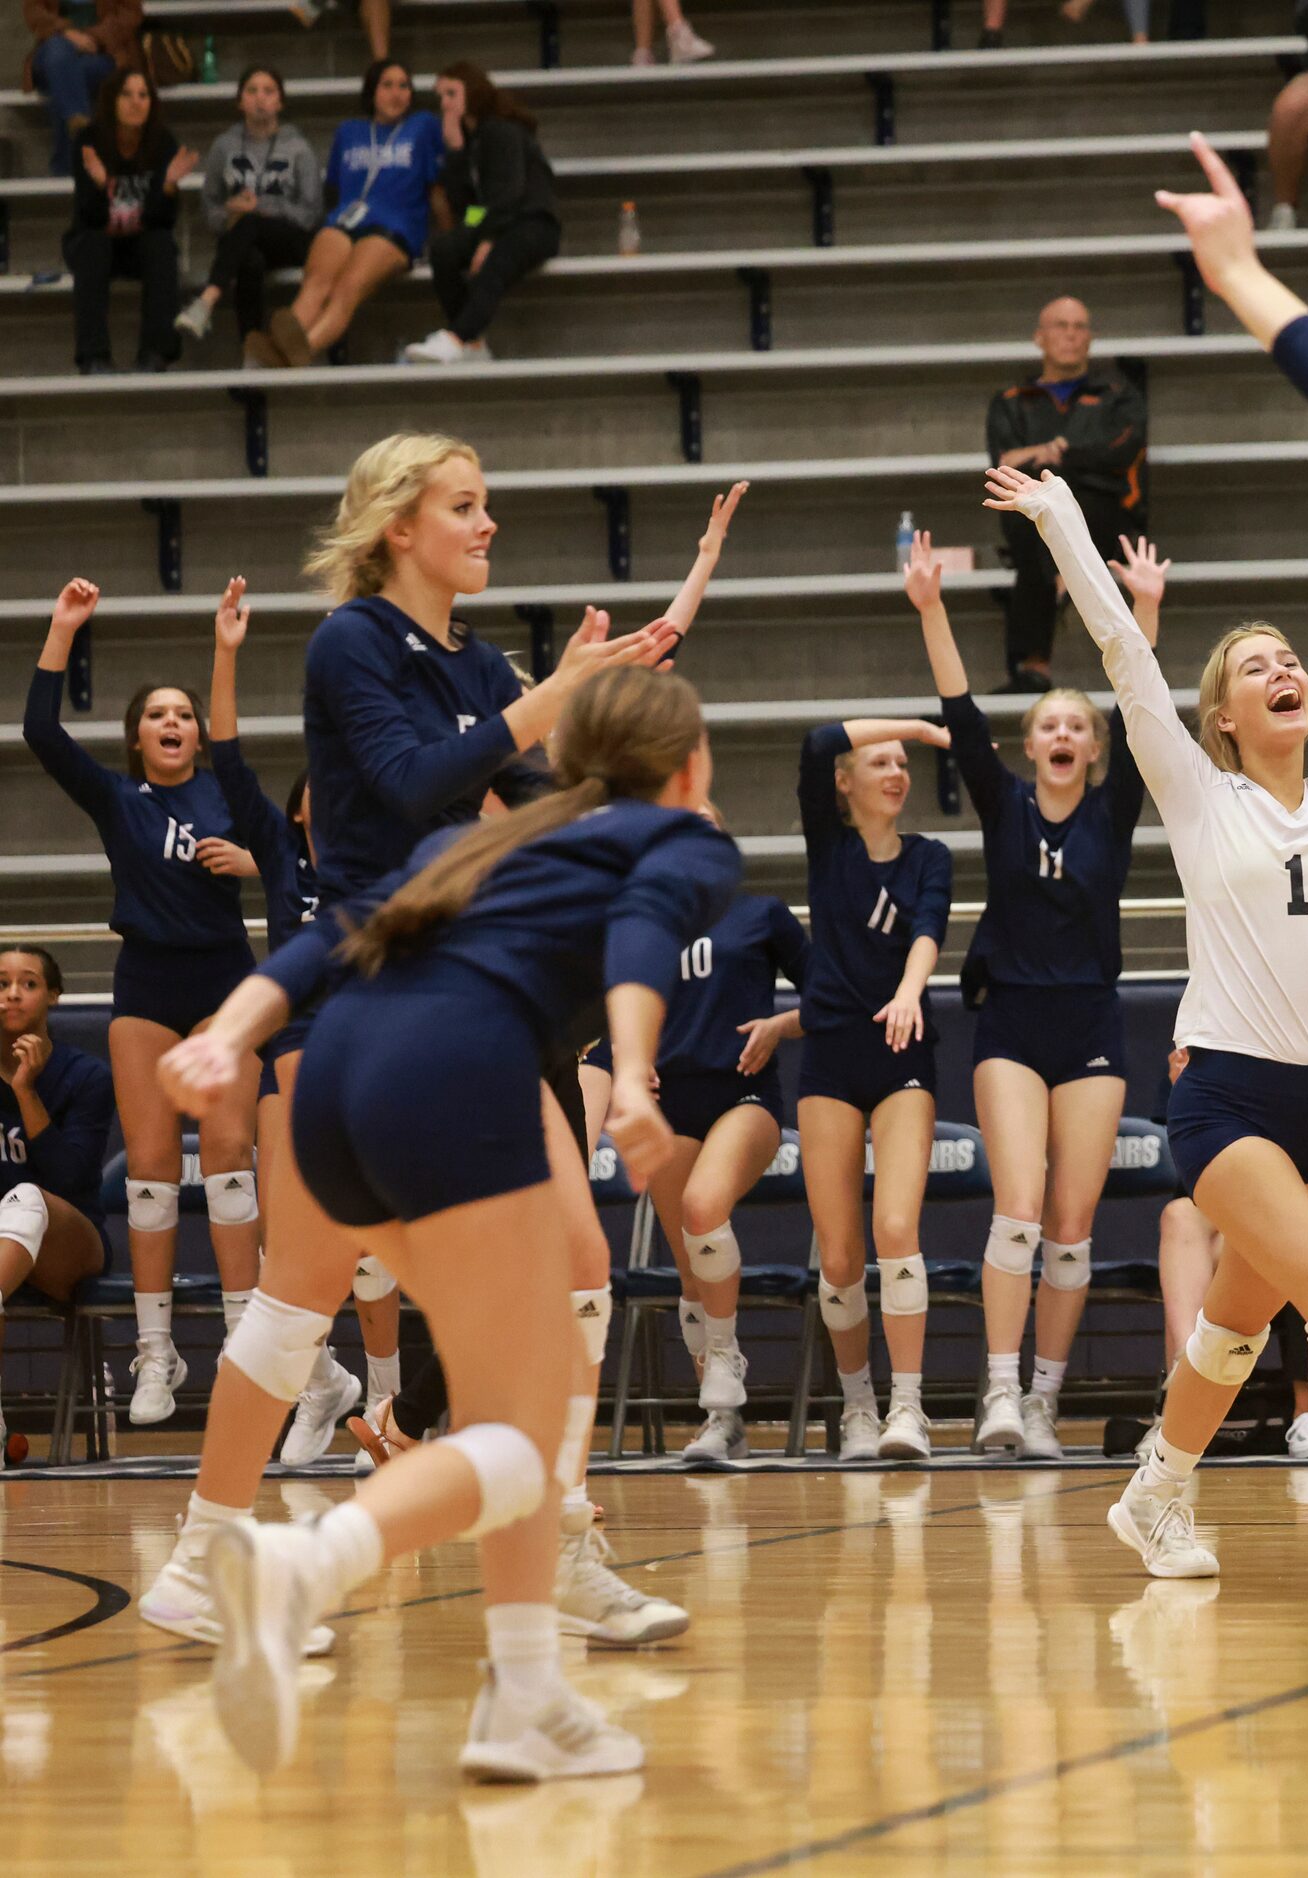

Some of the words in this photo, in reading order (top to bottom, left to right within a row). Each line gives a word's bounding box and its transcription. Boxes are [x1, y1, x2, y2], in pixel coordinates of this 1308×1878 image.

[164, 816, 197, 862] 15
[867, 886, 898, 935] 11
[680, 936, 713, 981] 10
